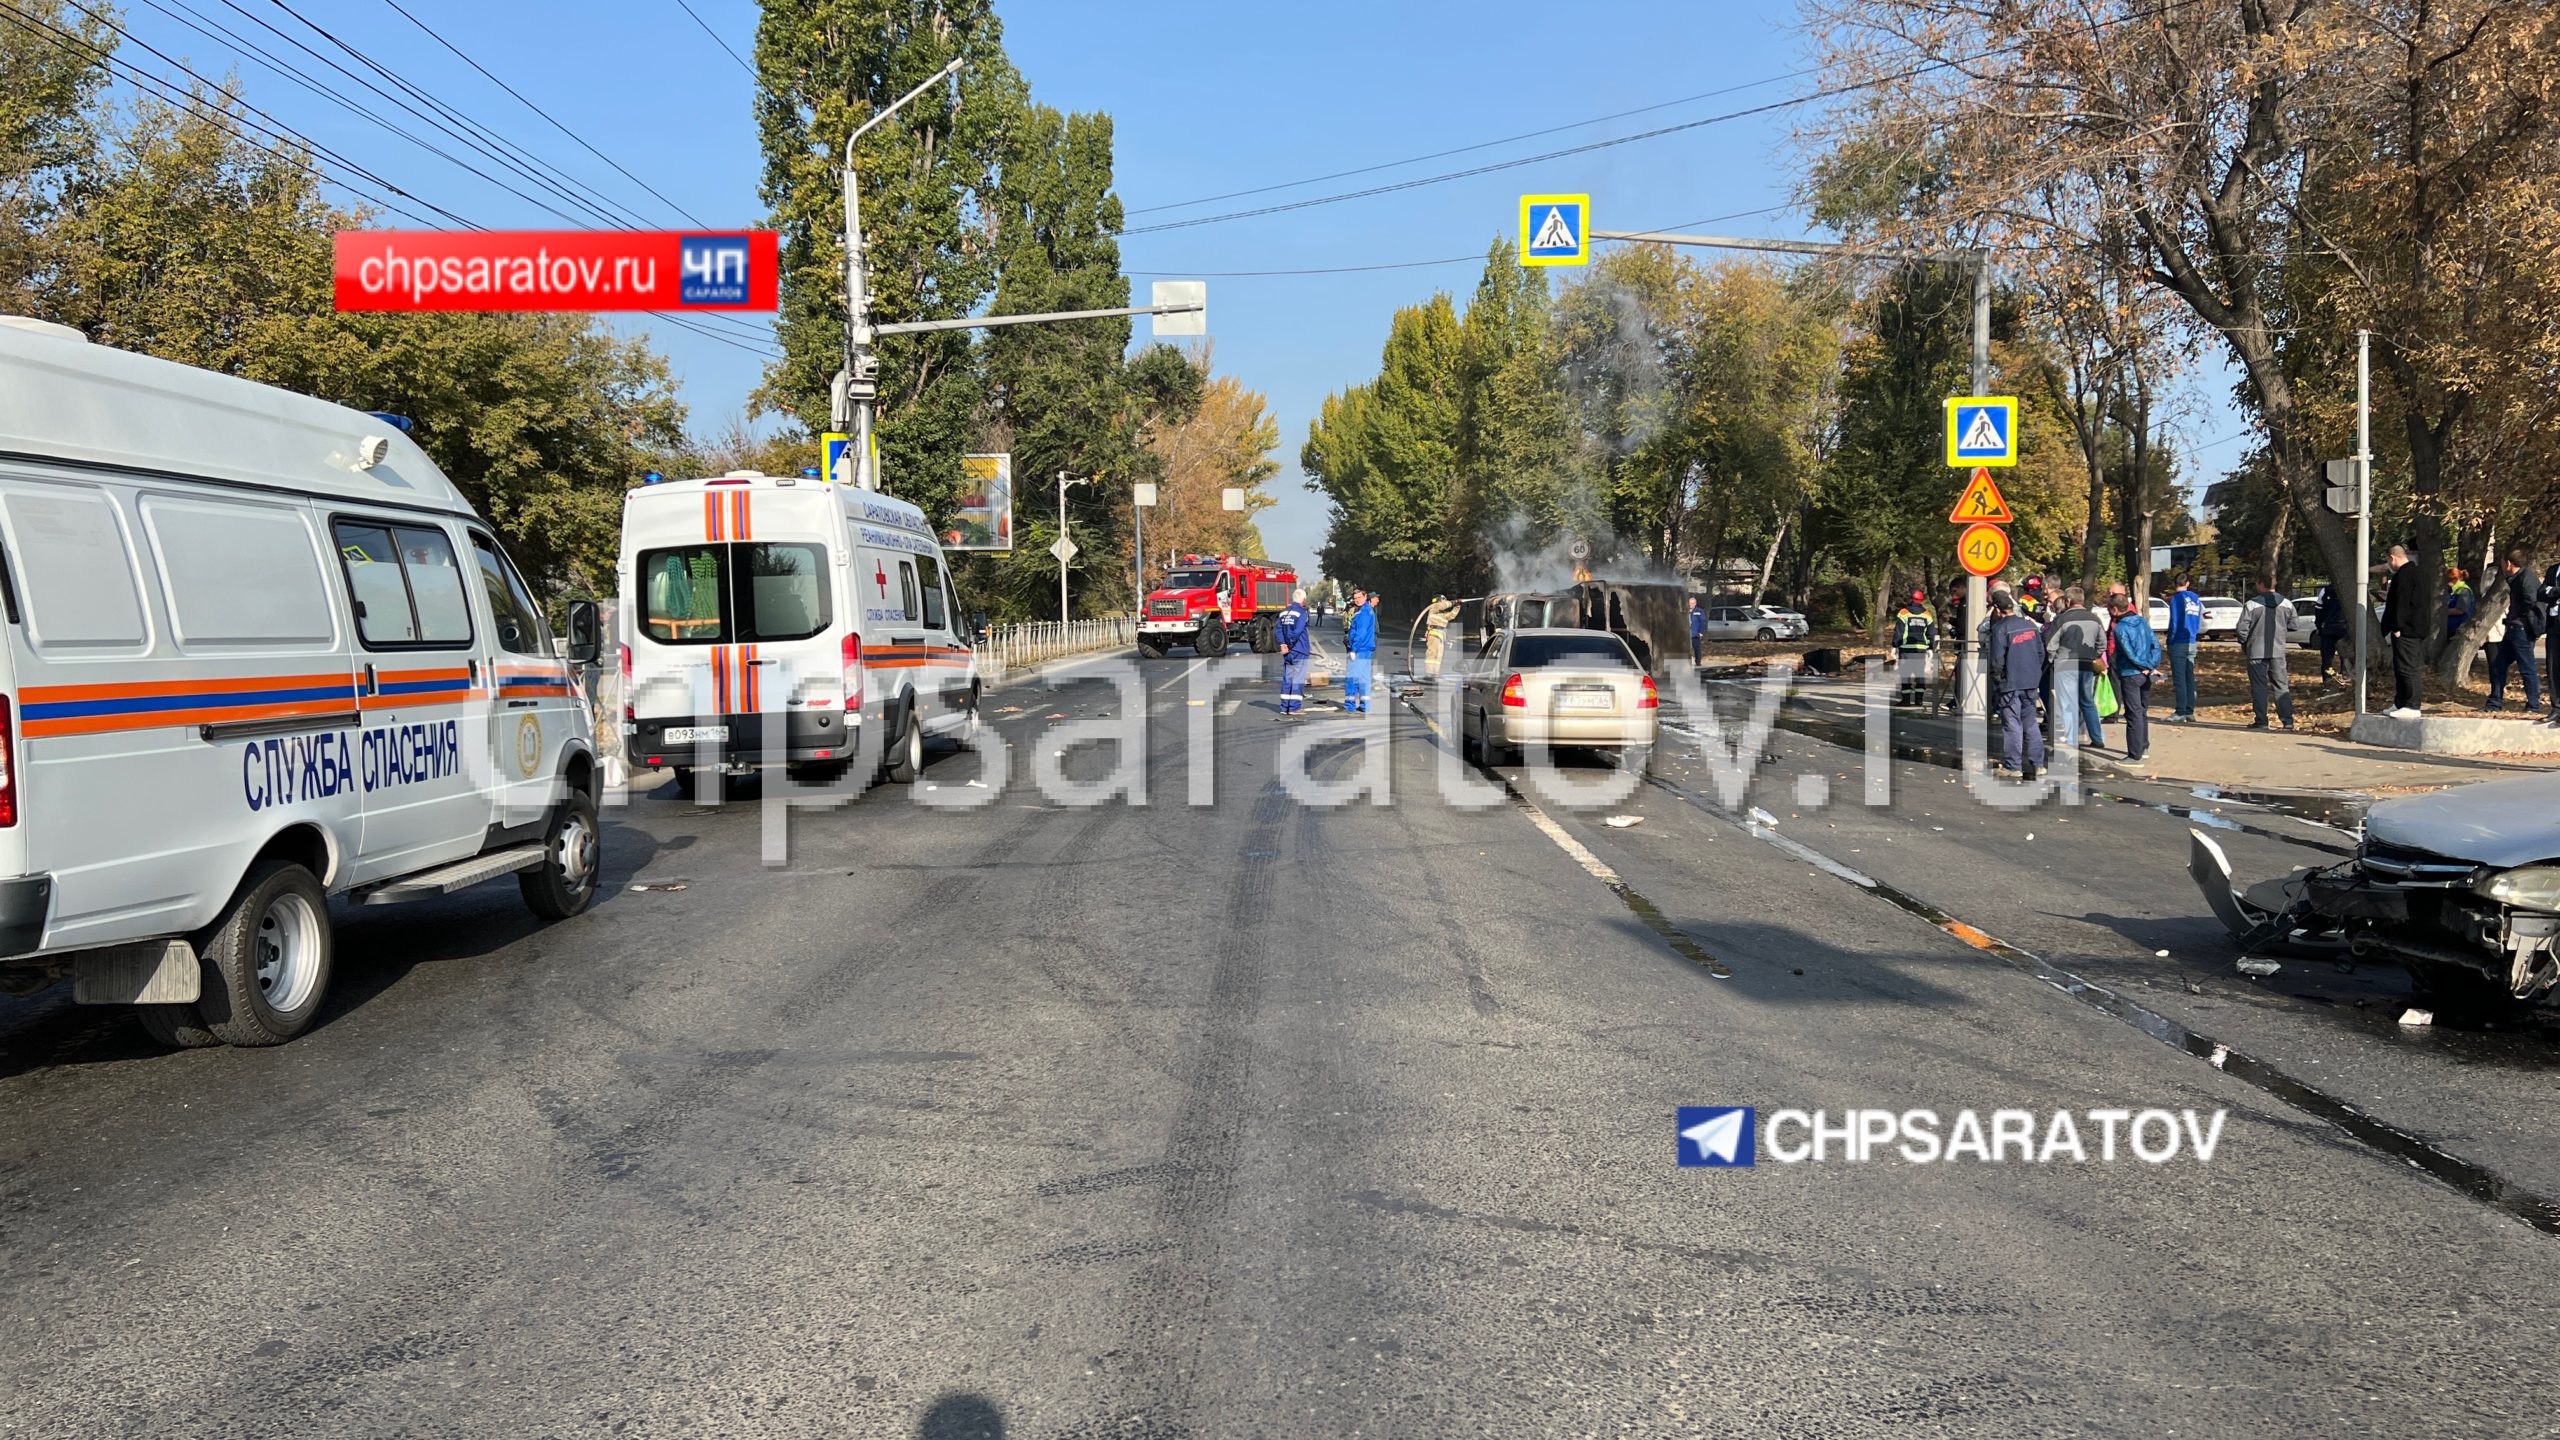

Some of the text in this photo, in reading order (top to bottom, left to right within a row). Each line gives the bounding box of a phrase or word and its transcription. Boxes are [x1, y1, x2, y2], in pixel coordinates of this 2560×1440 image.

[1968, 540, 1998, 561] 40
[243, 731, 354, 812] СЛУЖБА
[361, 720, 459, 793] СПАСЕНИЯ
